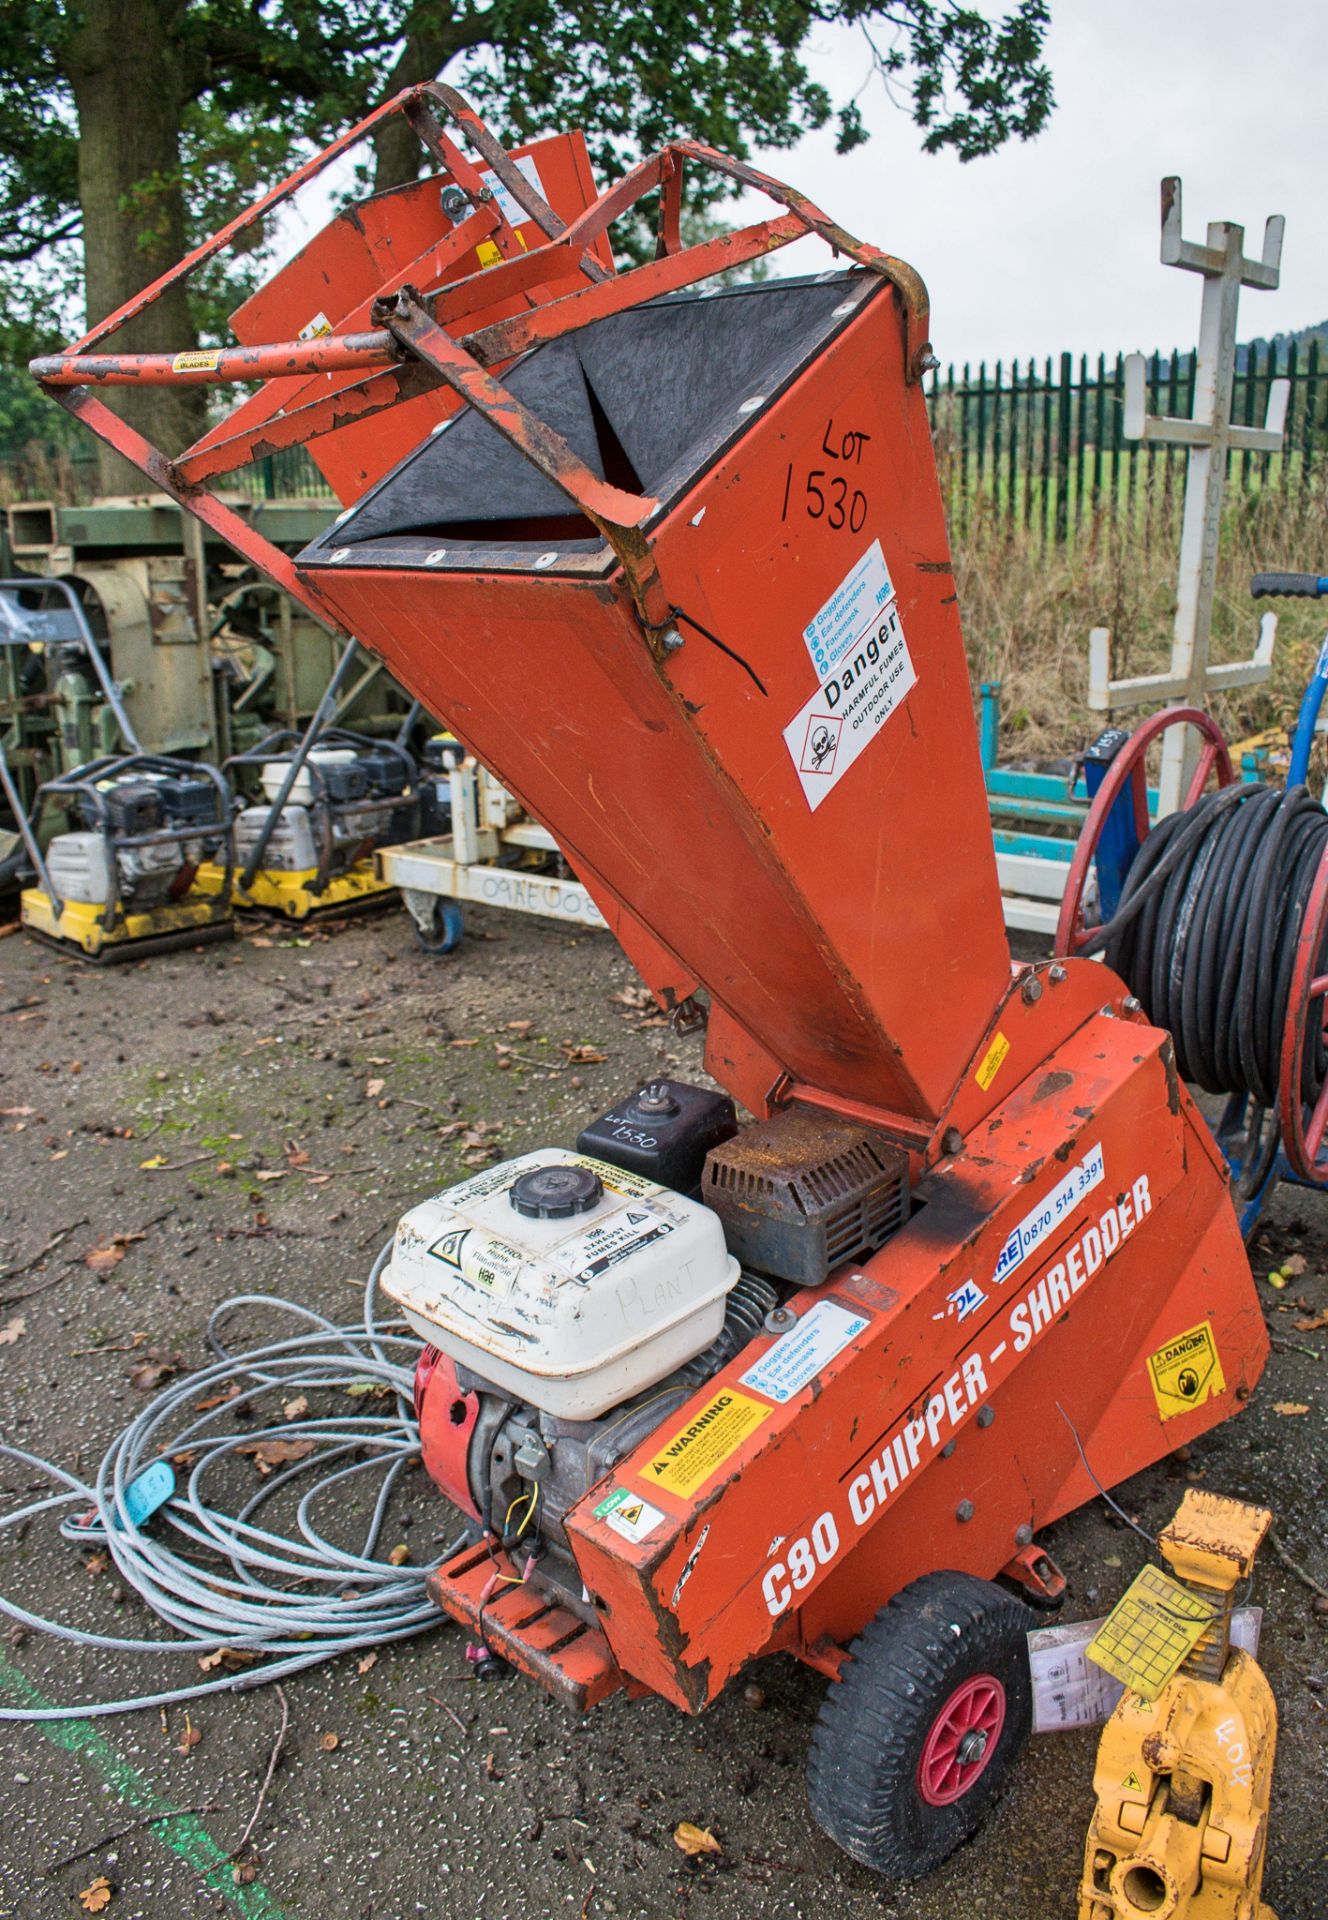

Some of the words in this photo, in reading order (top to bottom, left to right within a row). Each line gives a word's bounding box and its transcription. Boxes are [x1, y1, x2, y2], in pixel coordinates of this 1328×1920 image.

[180, 361, 210, 369] BLADES
[822, 418, 872, 465] LOT
[781, 462, 868, 534] 1530
[817, 590, 846, 626] Goggles
[821, 621, 834, 639] Ear
[834, 581, 867, 622] defenders
[825, 607, 860, 651] Facemask
[829, 631, 854, 662] Gloves
[823, 611, 897, 711] Danger
[842, 673, 880, 721] HARMFUL
[878, 639, 905, 675] FUMES
[852, 681, 890, 731] OUTDOOR
[889, 661, 905, 685] USE
[874, 696, 895, 726] ONLY
[612, 1126, 658, 1149] 1530
[1023, 1210, 1052, 1247] 0870
[1055, 1186, 1074, 1215] 514
[1078, 1157, 1103, 1192] 3391
[488, 1239, 524, 1261] PETROL
[584, 1227, 626, 1251] EXHAUST
[586, 1241, 619, 1261] FUMES
[619, 1229, 641, 1242] KILL
[757, 1342, 791, 1374] Goggles
[767, 1365, 782, 1378] Ear
[782, 1328, 820, 1365] defenders
[777, 1346, 817, 1383] Facemask
[1165, 1333, 1206, 1362] DANGER
[787, 1362, 817, 1388] Gloves
[761, 1511, 840, 1617] C80
[847, 1352, 989, 1526] CHIPPER
[1009, 1173, 1153, 1353] SHREDDER
[665, 1395, 734, 1458] WARNING
[1173, 1621, 1189, 1634] DUE
